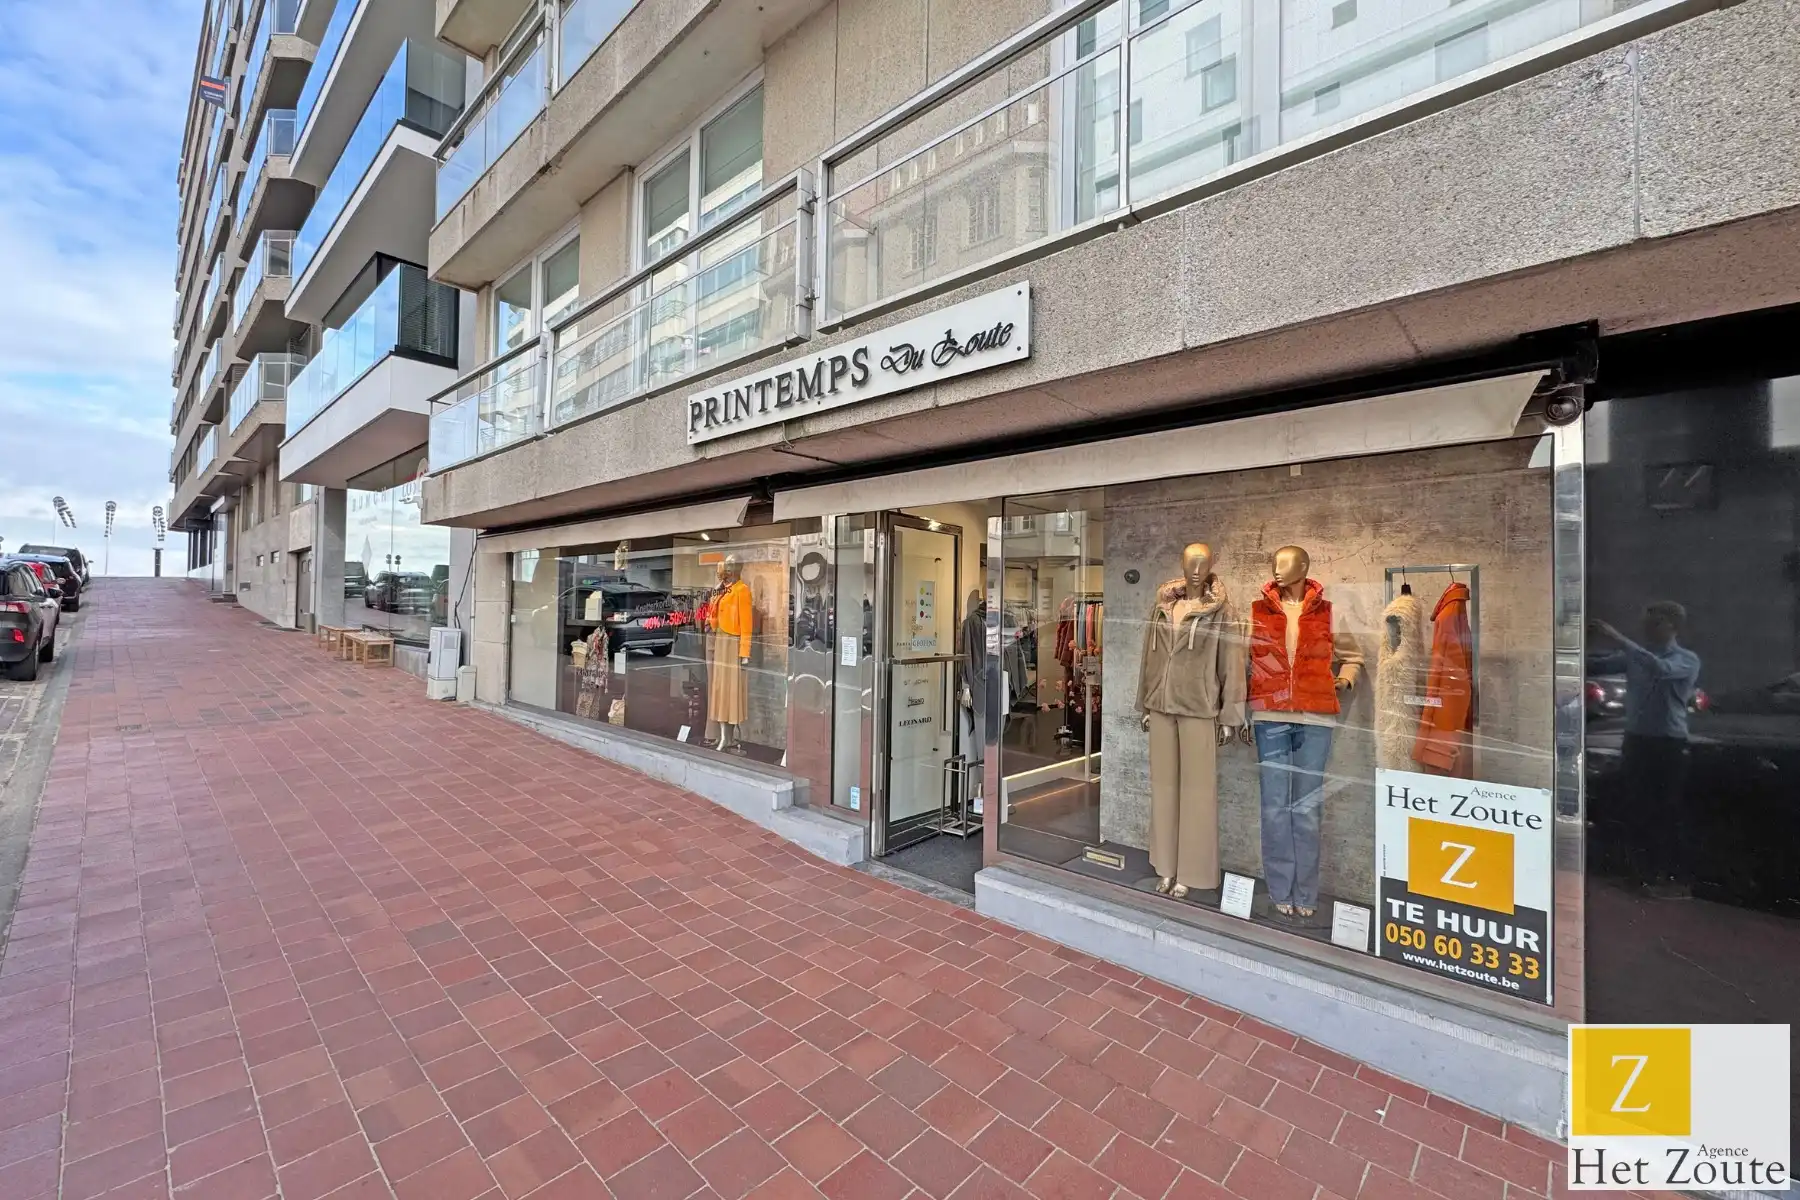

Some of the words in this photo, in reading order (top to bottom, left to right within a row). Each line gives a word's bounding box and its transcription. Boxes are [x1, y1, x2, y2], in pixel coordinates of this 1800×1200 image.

[689, 346, 869, 433] PRINTEMPS
[881, 343, 925, 374] Du
[931, 321, 1014, 366] Zoute
[899, 716, 932, 727] LEONARD
[1386, 785, 1438, 813] Het
[1450, 794, 1543, 830] Zoute
[1471, 786, 1517, 801] Agence
[1440, 841, 1478, 889] Z
[1386, 897, 1424, 924] TE
[1437, 909, 1540, 953] HUUR
[1385, 922, 1426, 950] 050
[1434, 935, 1462, 960] 60
[1470, 943, 1500, 969] 33
[1508, 952, 1540, 980] 33
[1403, 951, 1520, 991] www.hetzoute.be
